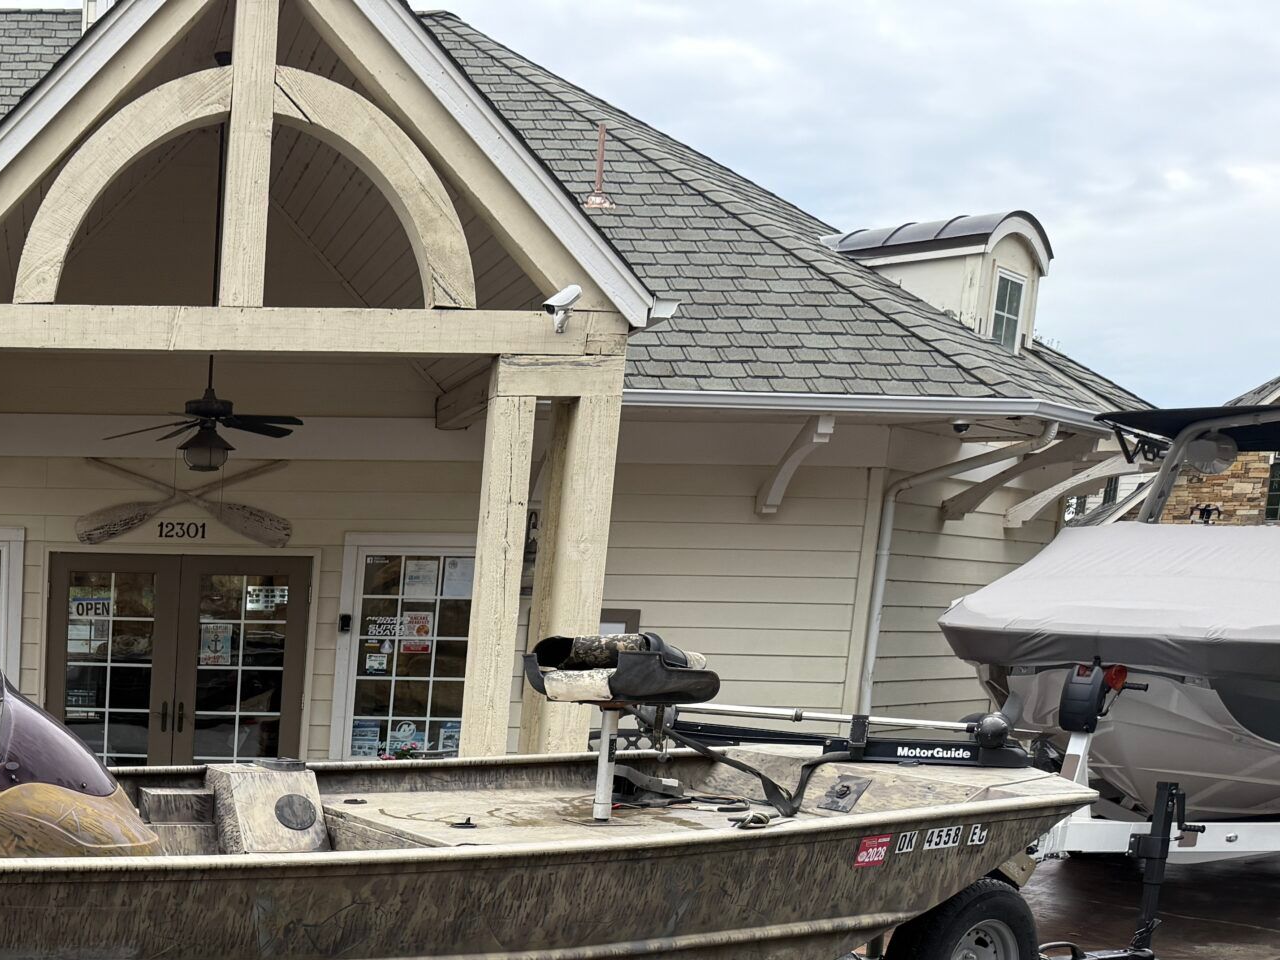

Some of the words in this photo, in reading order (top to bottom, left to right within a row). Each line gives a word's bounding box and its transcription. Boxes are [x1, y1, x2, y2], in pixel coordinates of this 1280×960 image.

[158, 522, 206, 539] 12301
[76, 602, 110, 616] OPEN
[897, 746, 971, 758] MotorGuide
[897, 833, 917, 852] OK
[926, 826, 961, 847] 4558
[865, 846, 887, 862] 2028
